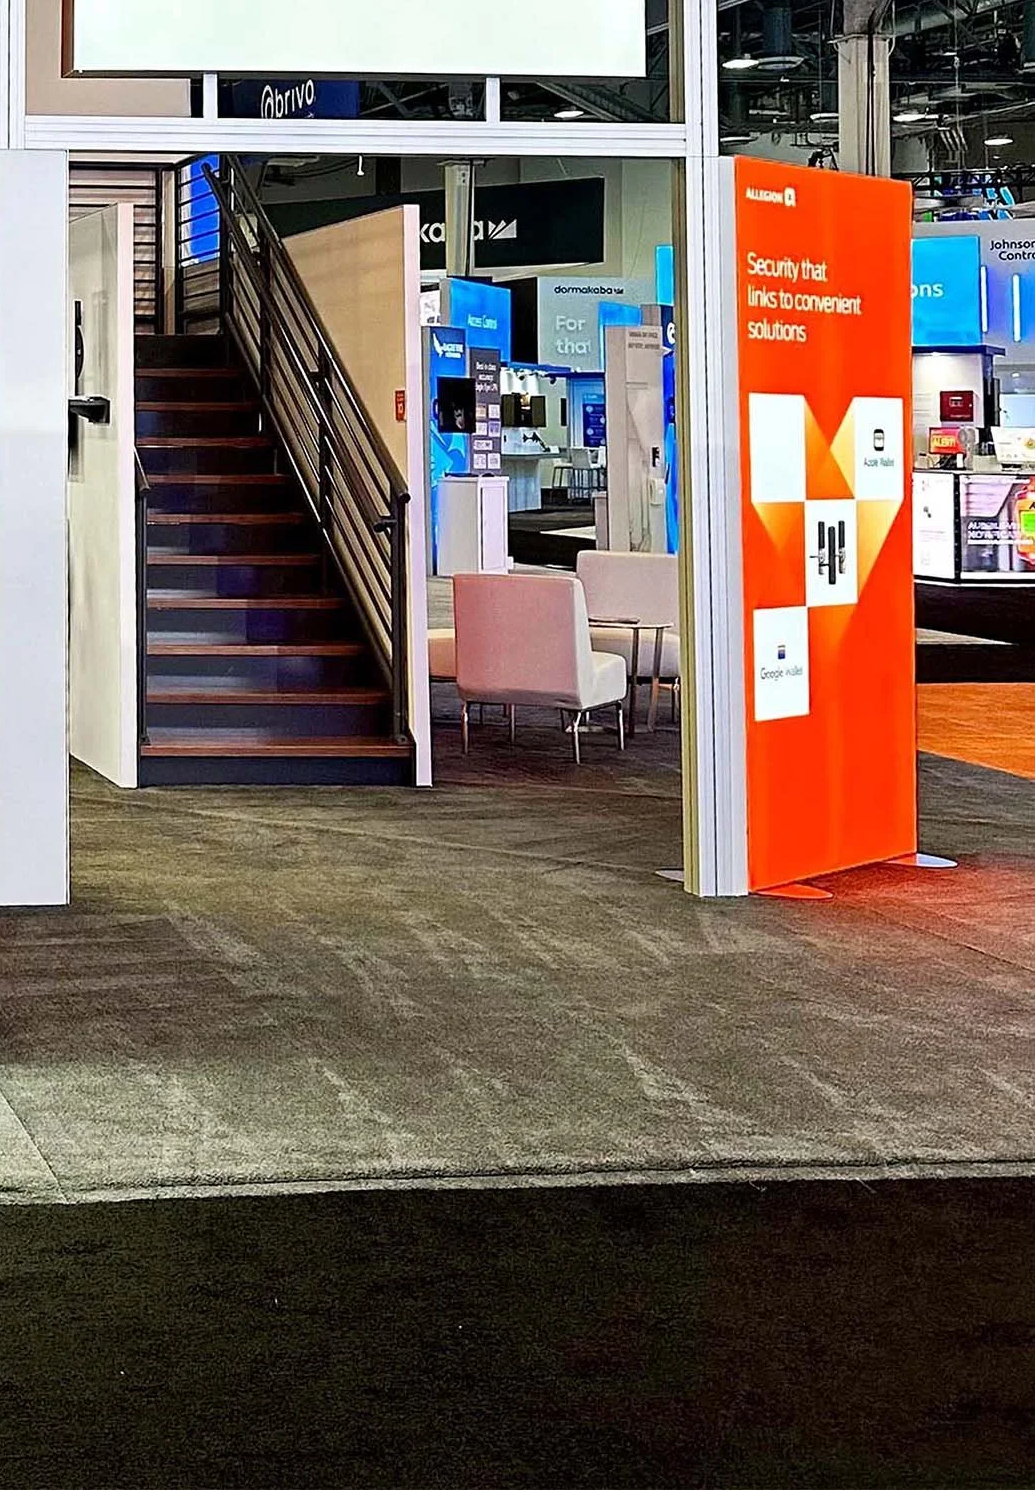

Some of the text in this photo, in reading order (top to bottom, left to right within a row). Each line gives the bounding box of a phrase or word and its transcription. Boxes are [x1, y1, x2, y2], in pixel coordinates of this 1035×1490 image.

[746, 251, 828, 284] Security that
[553, 285, 614, 295] dormakaba
[747, 283, 863, 316] links to convenient
[556, 315, 586, 331] For
[747, 317, 807, 343] solutions
